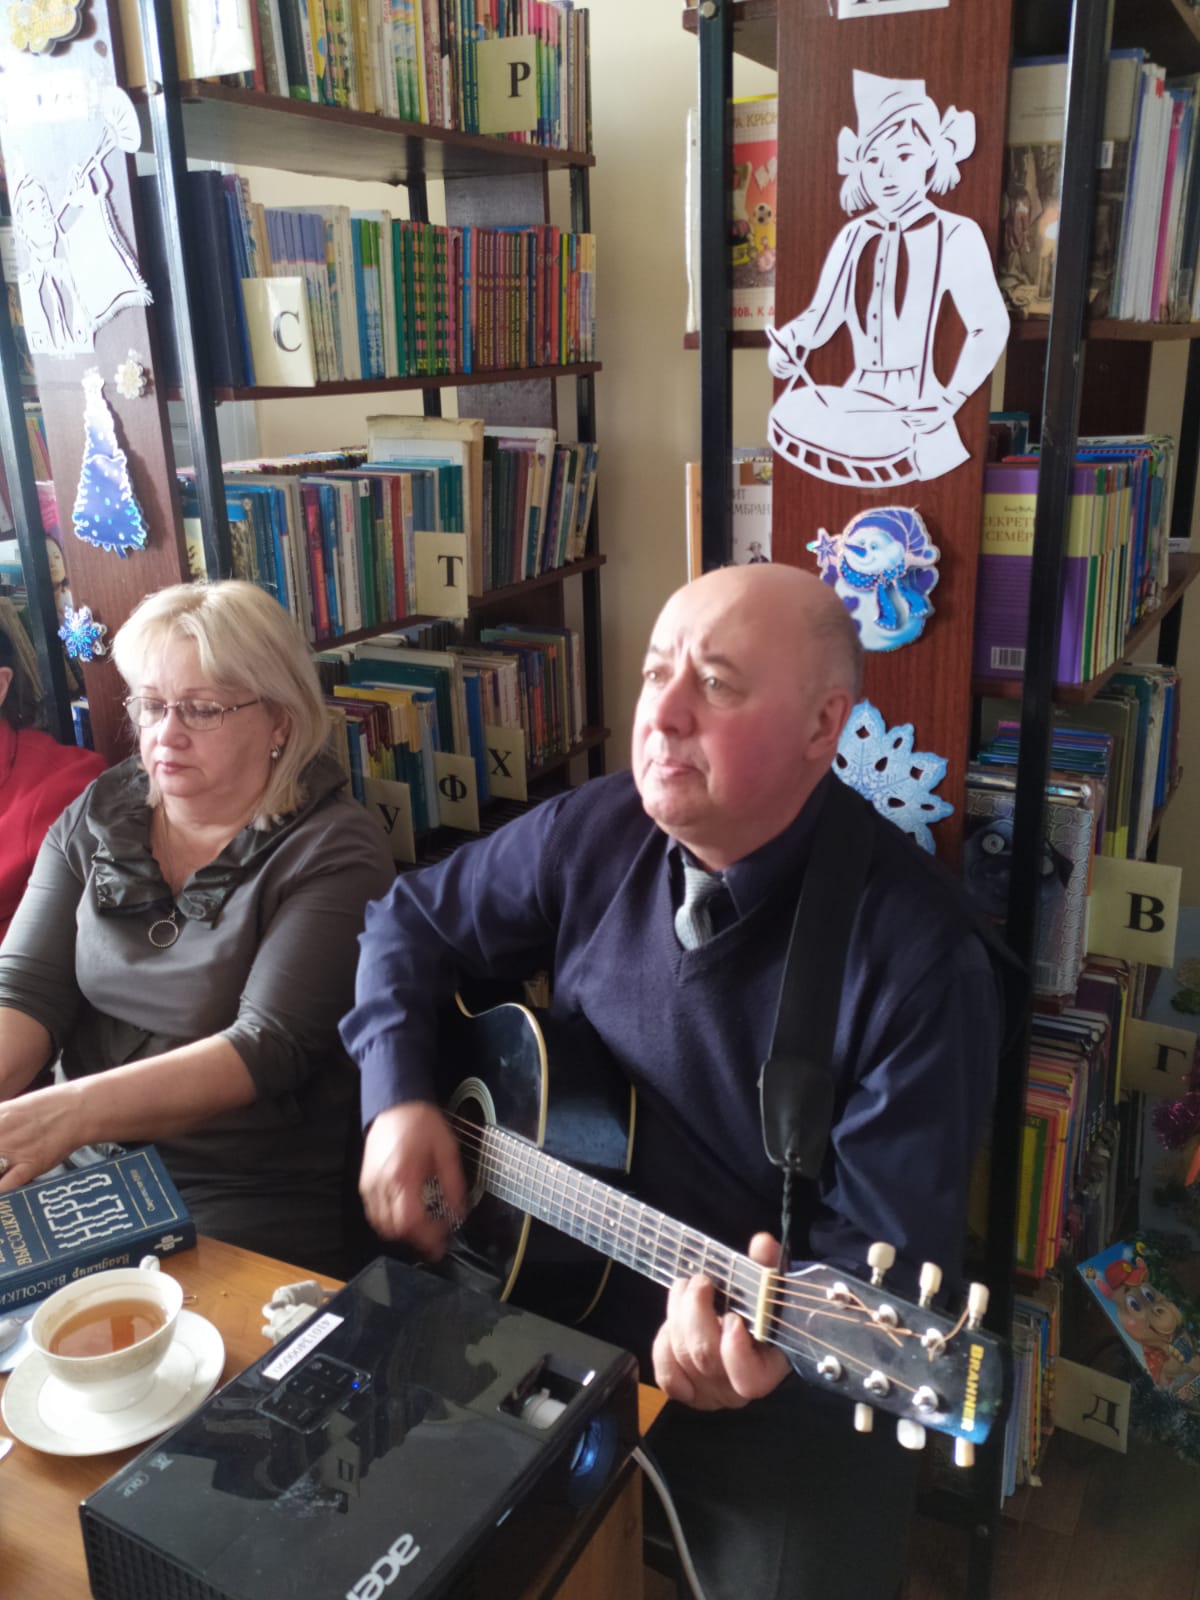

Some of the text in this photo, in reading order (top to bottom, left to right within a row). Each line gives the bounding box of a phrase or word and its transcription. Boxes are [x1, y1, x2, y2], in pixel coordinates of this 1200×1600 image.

[505, 61, 531, 98] Р
[273, 310, 303, 352] С
[437, 553, 464, 588] Т
[488, 748, 513, 778] Х
[438, 773, 468, 802] Ф
[376, 802, 401, 835] У
[1123, 891, 1166, 934] В
[1152, 1042, 1188, 1073] Г
[38, 1174, 133, 1249] НЕРВ
[1082, 1394, 1121, 1437] Д
